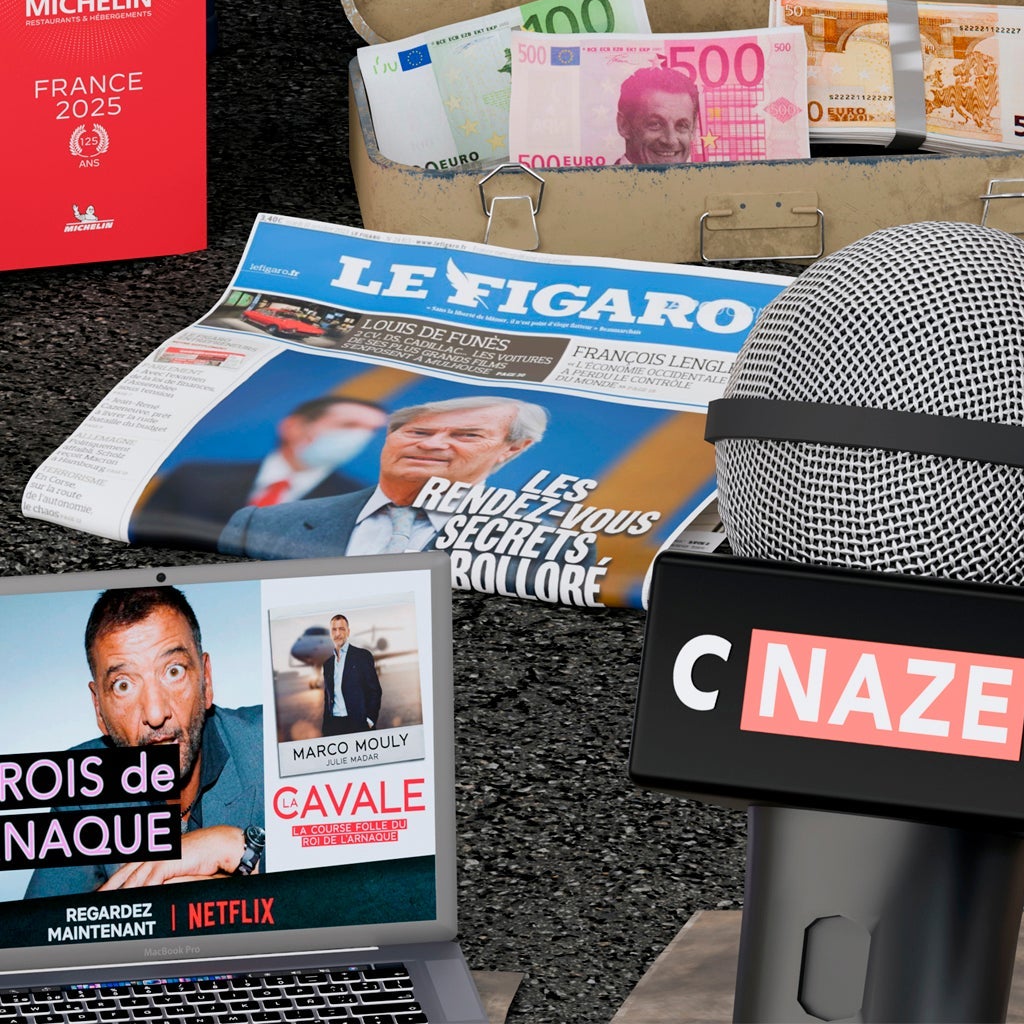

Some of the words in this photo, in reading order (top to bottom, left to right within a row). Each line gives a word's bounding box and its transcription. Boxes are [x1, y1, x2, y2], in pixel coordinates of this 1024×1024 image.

[26, 16, 81, 26] RESTAURANTS
[90, 11, 152, 21] HÉBERGEMENTS
[785, 4, 803, 17] 50
[517, 43, 547, 65] 500
[774, 43, 791, 52] 500
[667, 42, 765, 87] 500
[34, 72, 143, 99] FRANCE
[55, 97, 122, 120] 2025
[827, 107, 866, 116] EURO
[80, 136, 99, 147] 125
[78, 158, 100, 168] ANS
[439, 151, 480, 170] EURO
[563, 155, 606, 167] EURO
[64, 222, 113, 233] MICHELIN
[250, 263, 300, 278] lefigaro.fr
[330, 255, 437, 299] LE
[446, 256, 754, 334] FIGARO
[361, 318, 417, 337] LOUIS
[417, 325, 446, 342] DE
[447, 330, 511, 353] FUNÈS
[341, 342, 414, 360] S'EXPOSENT
[426, 357, 493, 376] MULHOUSE
[347, 336, 366, 346] DE
[366, 338, 390, 350] SES
[390, 341, 421, 354] PLUS
[421, 348, 471, 364] GRANDS
[473, 357, 508, 370] FILMS
[473, 350, 495, 361] LES
[498, 353, 554, 365] VOITURES
[572, 344, 666, 366] FRANÇOIS
[555, 374, 569, 383] DU
[570, 376, 618, 389] MONDE
[572, 369, 614, 381] PERDU
[614, 373, 627, 382] LE
[630, 375, 693, 390] CONTRÔLE
[647, 368, 728, 385] OCCIDENTALE
[522, 469, 598, 503] LES
[412, 476, 661, 536] RENDEZ-VOUS
[436, 515, 597, 564] SECRETS
[450, 550, 614, 608] BOLLORÉ
[672, 634, 733, 711] C
[758, 642, 1014, 744] NAZE
[293, 741, 349, 761] MARCO
[355, 733, 409, 752] MOULY
[326, 757, 348, 767] JULIE
[351, 753, 379, 763] MADAR
[121, 751, 175, 794] de
[273, 778, 426, 820] CAVALE
[282, 798, 298, 808] LA
[293, 826, 307, 836] LA
[311, 823, 352, 835] COURSE
[356, 821, 388, 832] FOLLE
[391, 819, 407, 830] DU
[303, 836, 320, 846] ROI
[323, 835, 337, 845] DE
[341, 831, 397, 845] L'ARNAQUE
[66, 903, 153, 923] REGARDEZ
[188, 897, 275, 929] NETFLIX
[47, 920, 157, 942] MAINTENANT
[144, 946, 184, 957] MacBook
[185, 945, 201, 954] Pro
